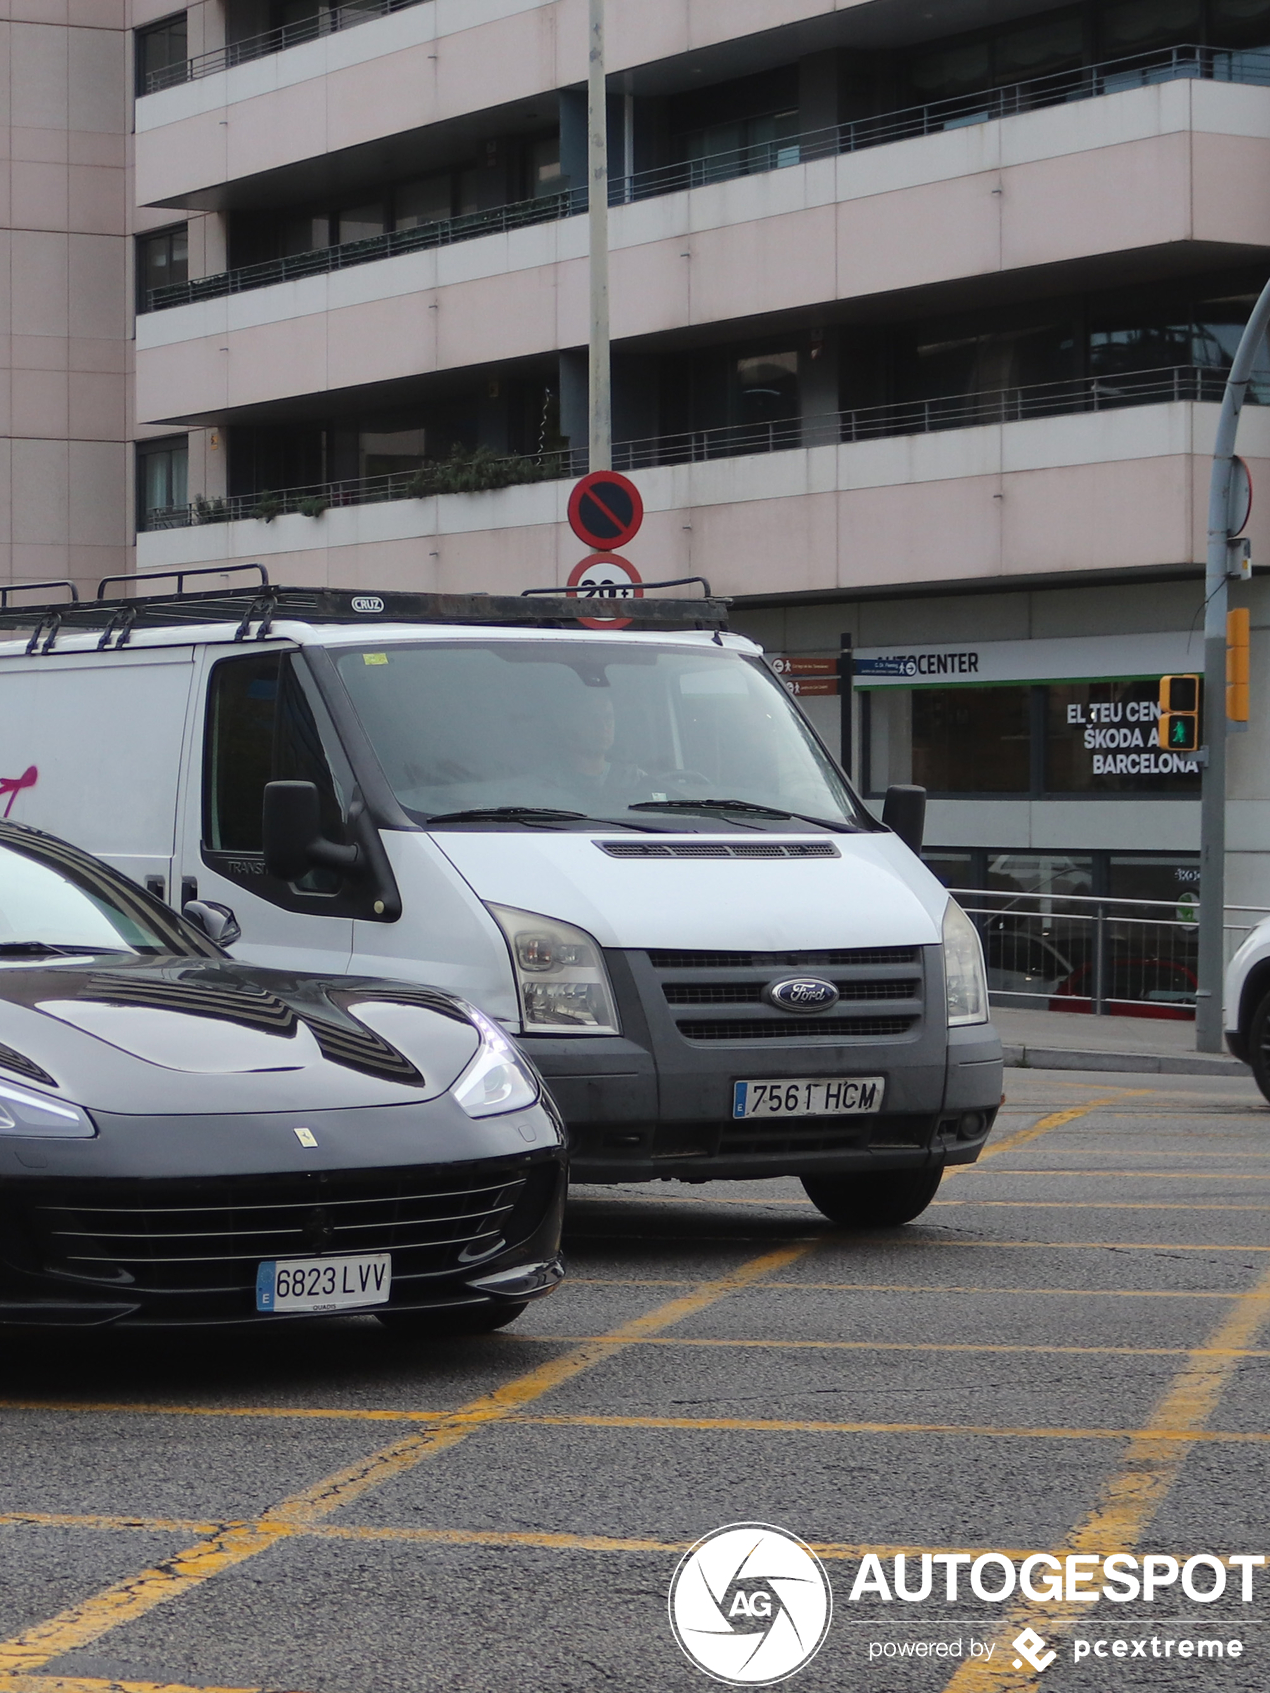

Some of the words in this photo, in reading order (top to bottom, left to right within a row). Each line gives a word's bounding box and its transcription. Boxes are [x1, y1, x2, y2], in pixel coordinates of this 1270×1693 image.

[354, 599, 381, 610] CRUZ
[877, 653, 978, 675] CENTER
[1067, 704, 1086, 724] EL
[1090, 702, 1122, 722] TEU
[1126, 701, 1161, 722] CEN
[1084, 724, 1144, 749] ŠKODA
[1147, 728, 1160, 748] A
[1092, 753, 1199, 774] BARCELONA
[790, 983, 826, 1001] Ford
[752, 1084, 812, 1112] 7561
[824, 1082, 876, 1110] HCM
[737, 1104, 744, 1112] E
[276, 1266, 336, 1298] 6823
[342, 1263, 386, 1294] LVV
[262, 1293, 270, 1304] E
